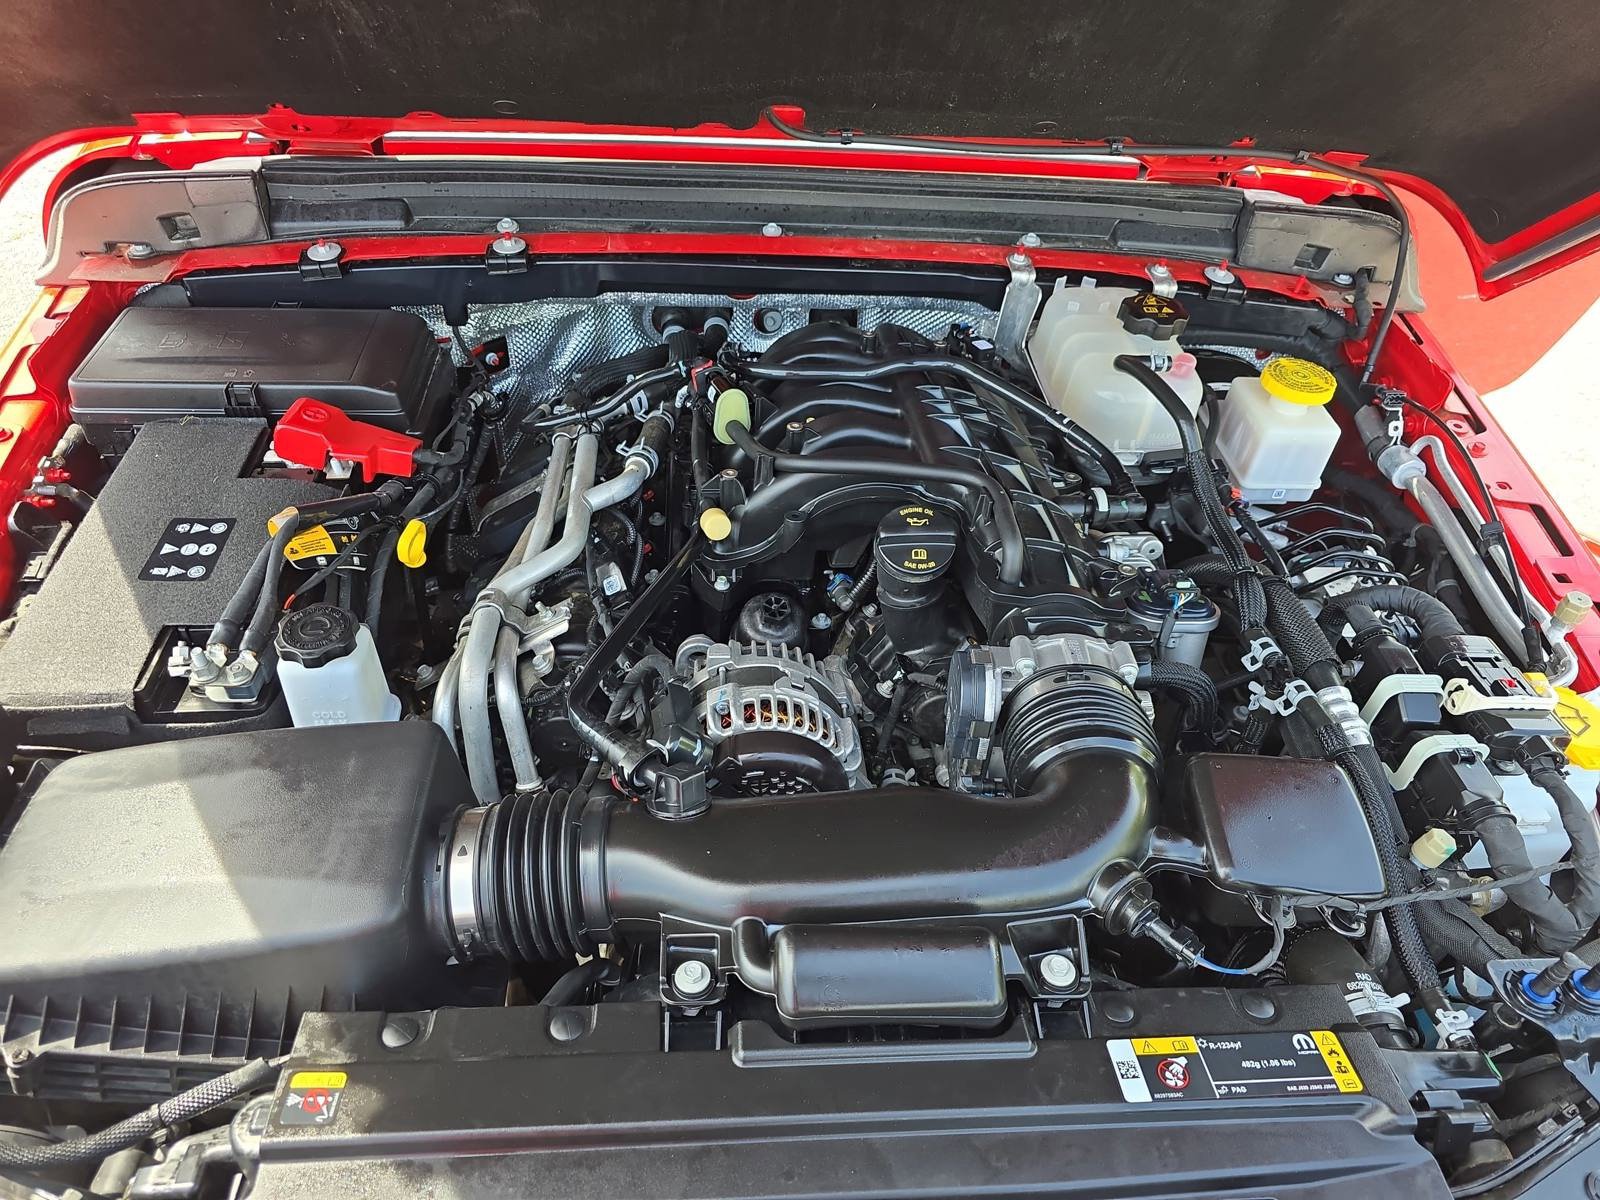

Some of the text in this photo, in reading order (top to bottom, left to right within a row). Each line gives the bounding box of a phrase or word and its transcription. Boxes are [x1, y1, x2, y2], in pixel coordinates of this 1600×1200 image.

[312, 711, 346, 719] COLD
[1354, 972, 1372, 981] RAD
[1208, 1041, 1242, 1050] R-1234yf
[1280, 1058, 1297, 1068] lbs)
[1231, 1086, 1247, 1094] PAG
